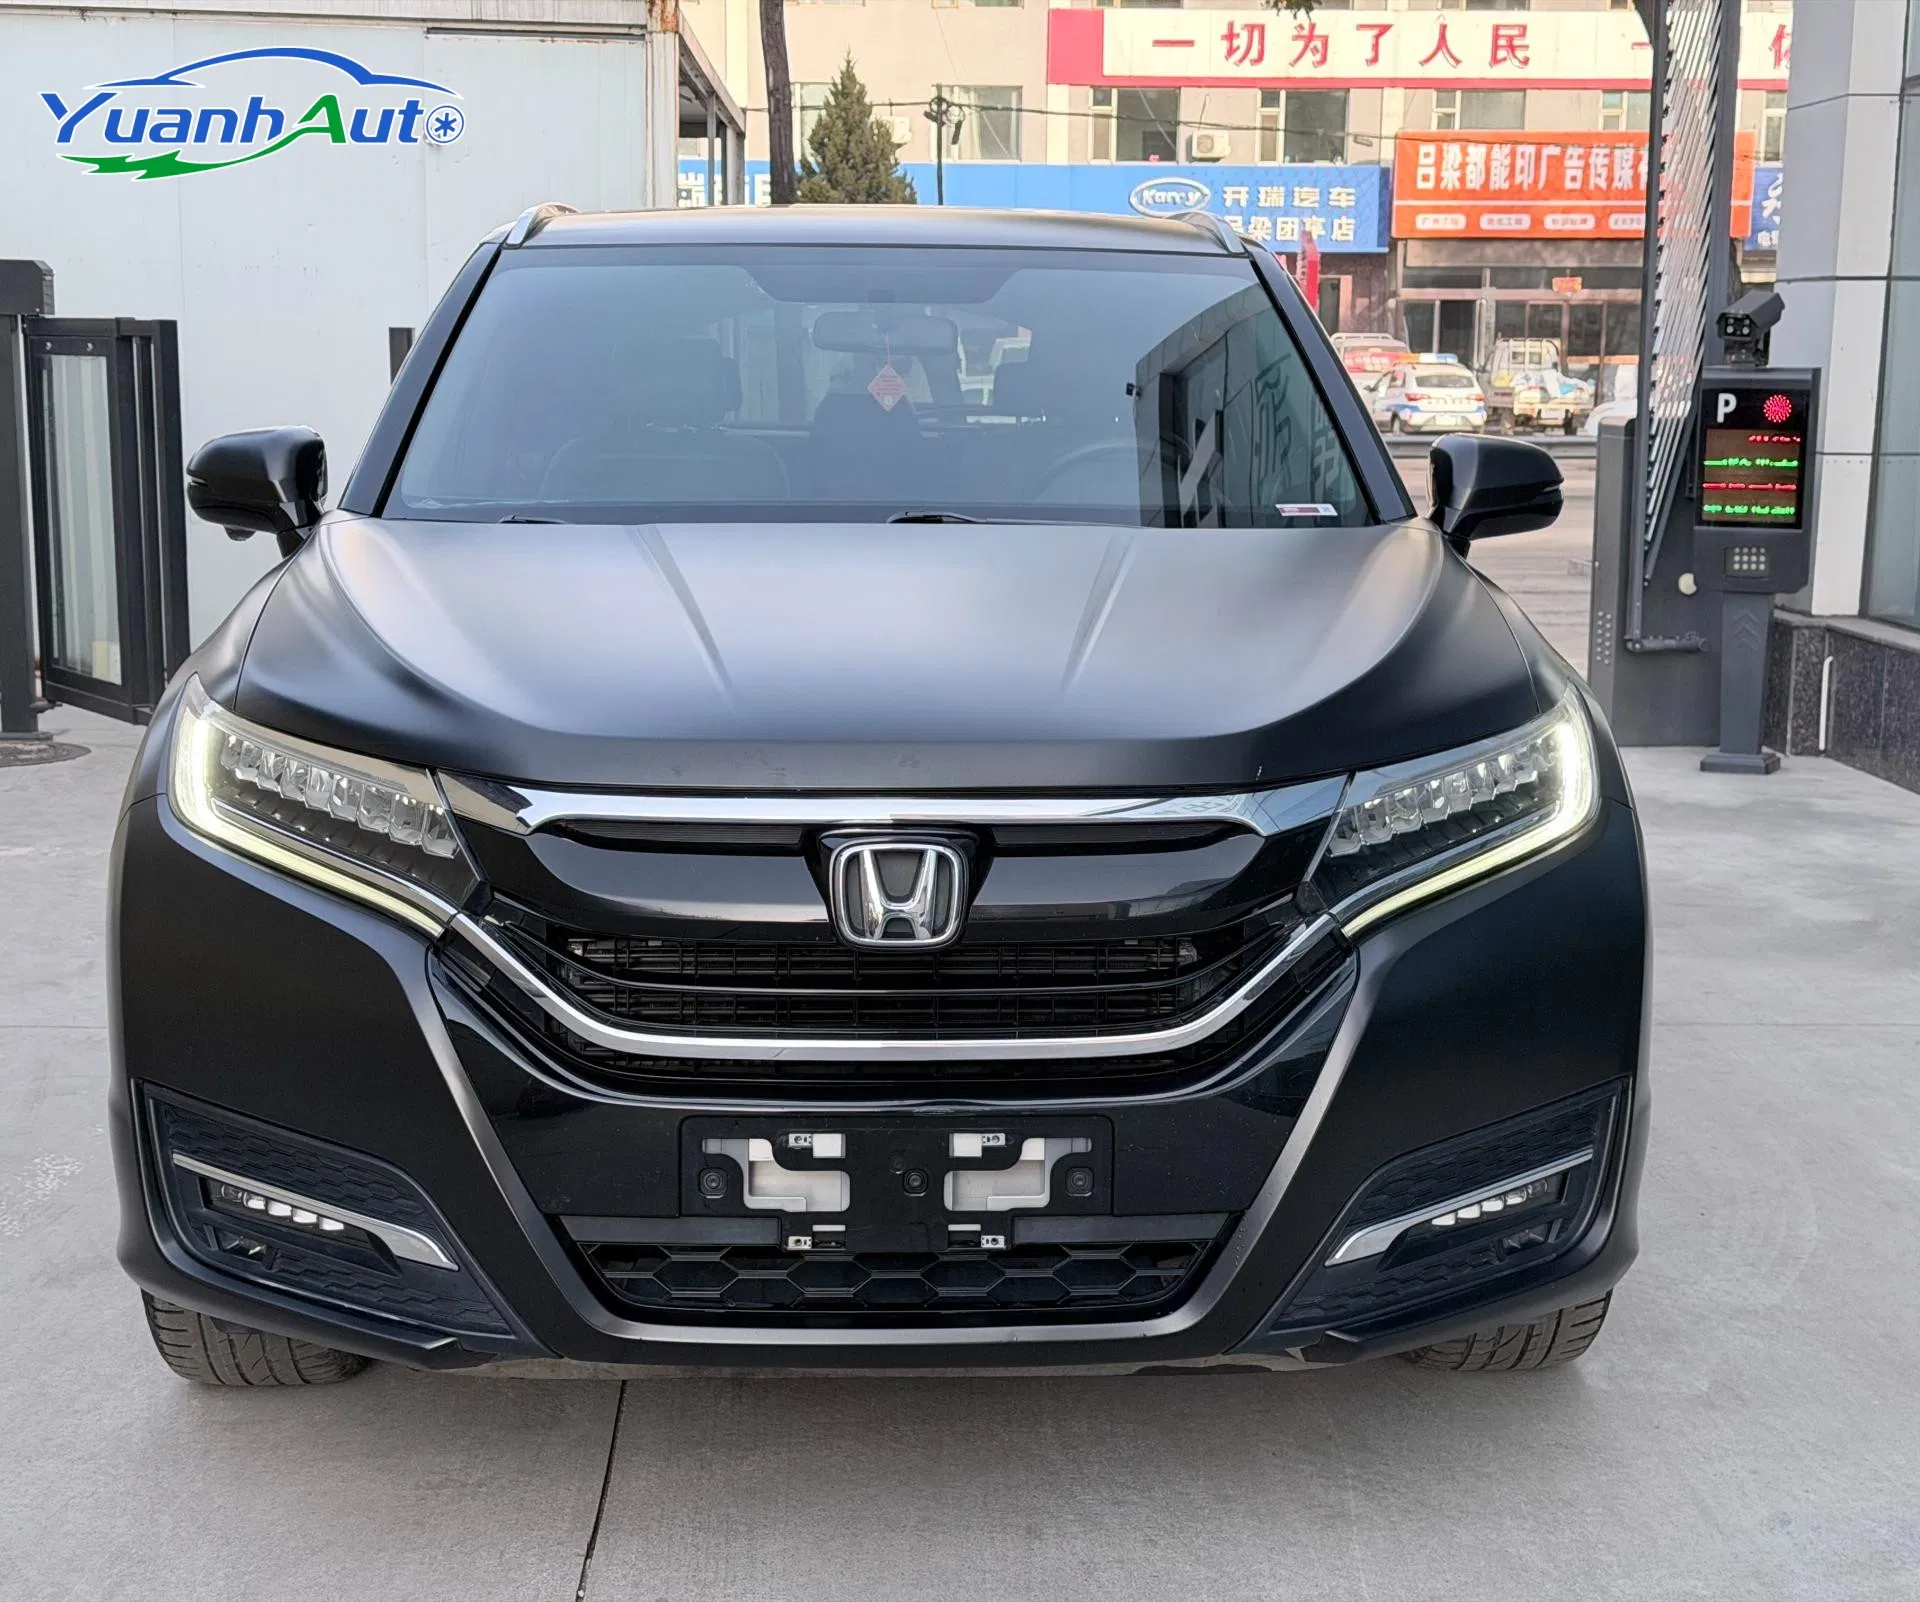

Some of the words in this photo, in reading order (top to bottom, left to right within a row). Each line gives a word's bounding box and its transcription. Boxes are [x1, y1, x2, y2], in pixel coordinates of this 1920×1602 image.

[1152, 20, 1531, 69] 一切为了人民
[1223, 186, 1356, 208] 开瑞汽车
[1716, 392, 1737, 423] P
